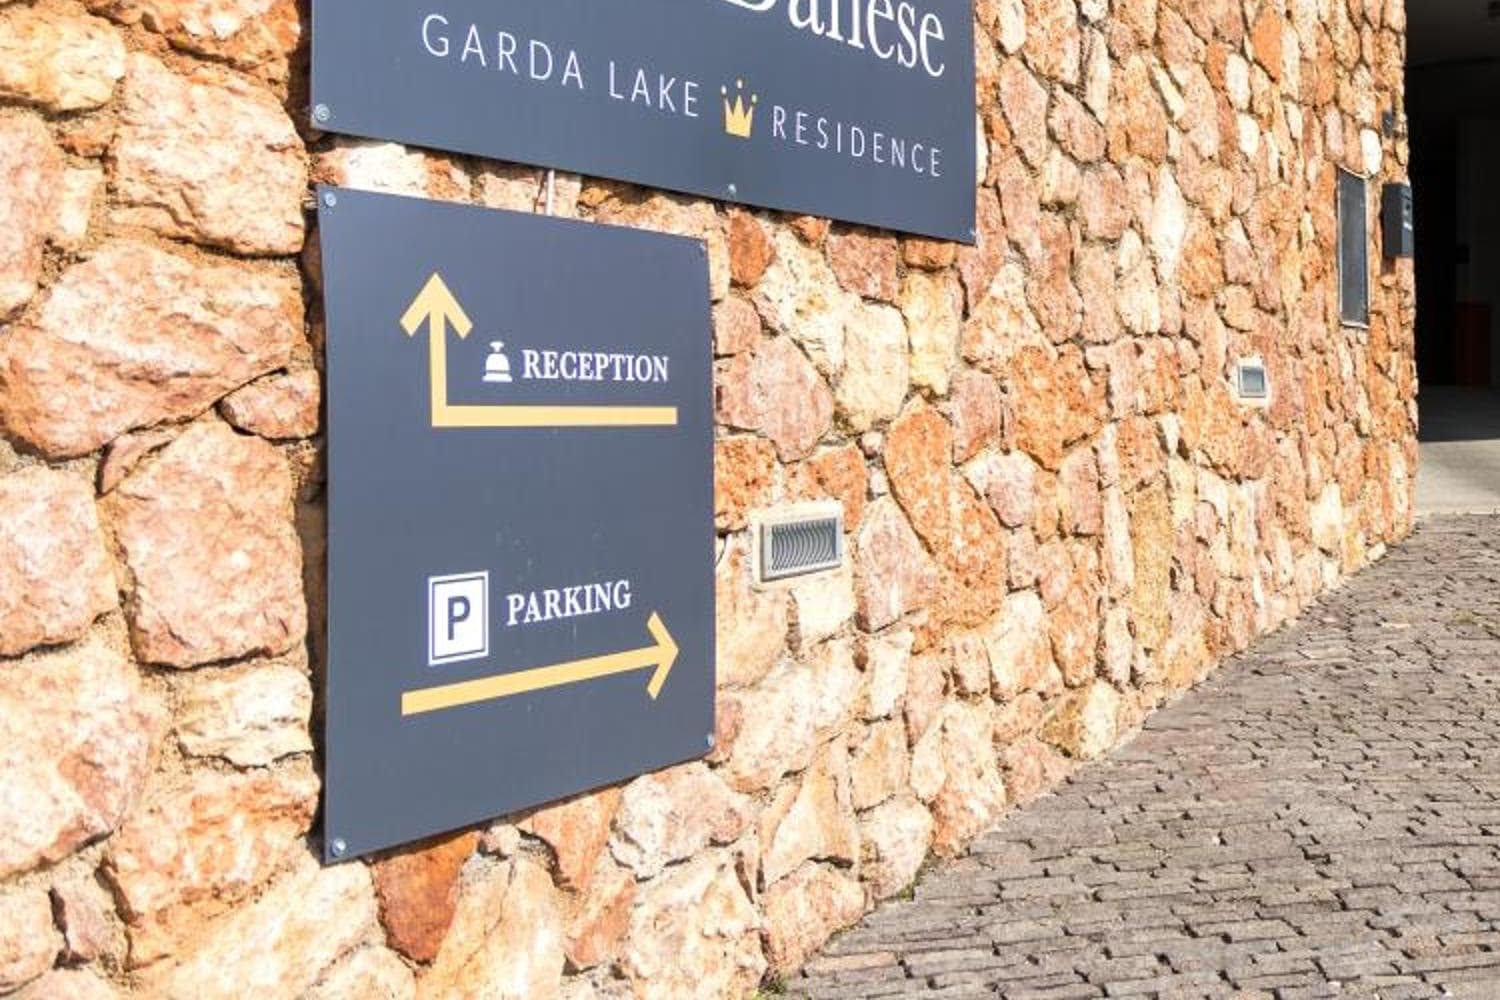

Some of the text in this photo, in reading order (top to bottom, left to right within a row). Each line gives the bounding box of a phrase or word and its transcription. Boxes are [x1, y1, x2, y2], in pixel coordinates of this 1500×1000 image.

[421, 13, 941, 178] GARDA LAKE RESIDENCE
[522, 349, 669, 382] RECEPTION
[447, 579, 632, 640] P PARKING
